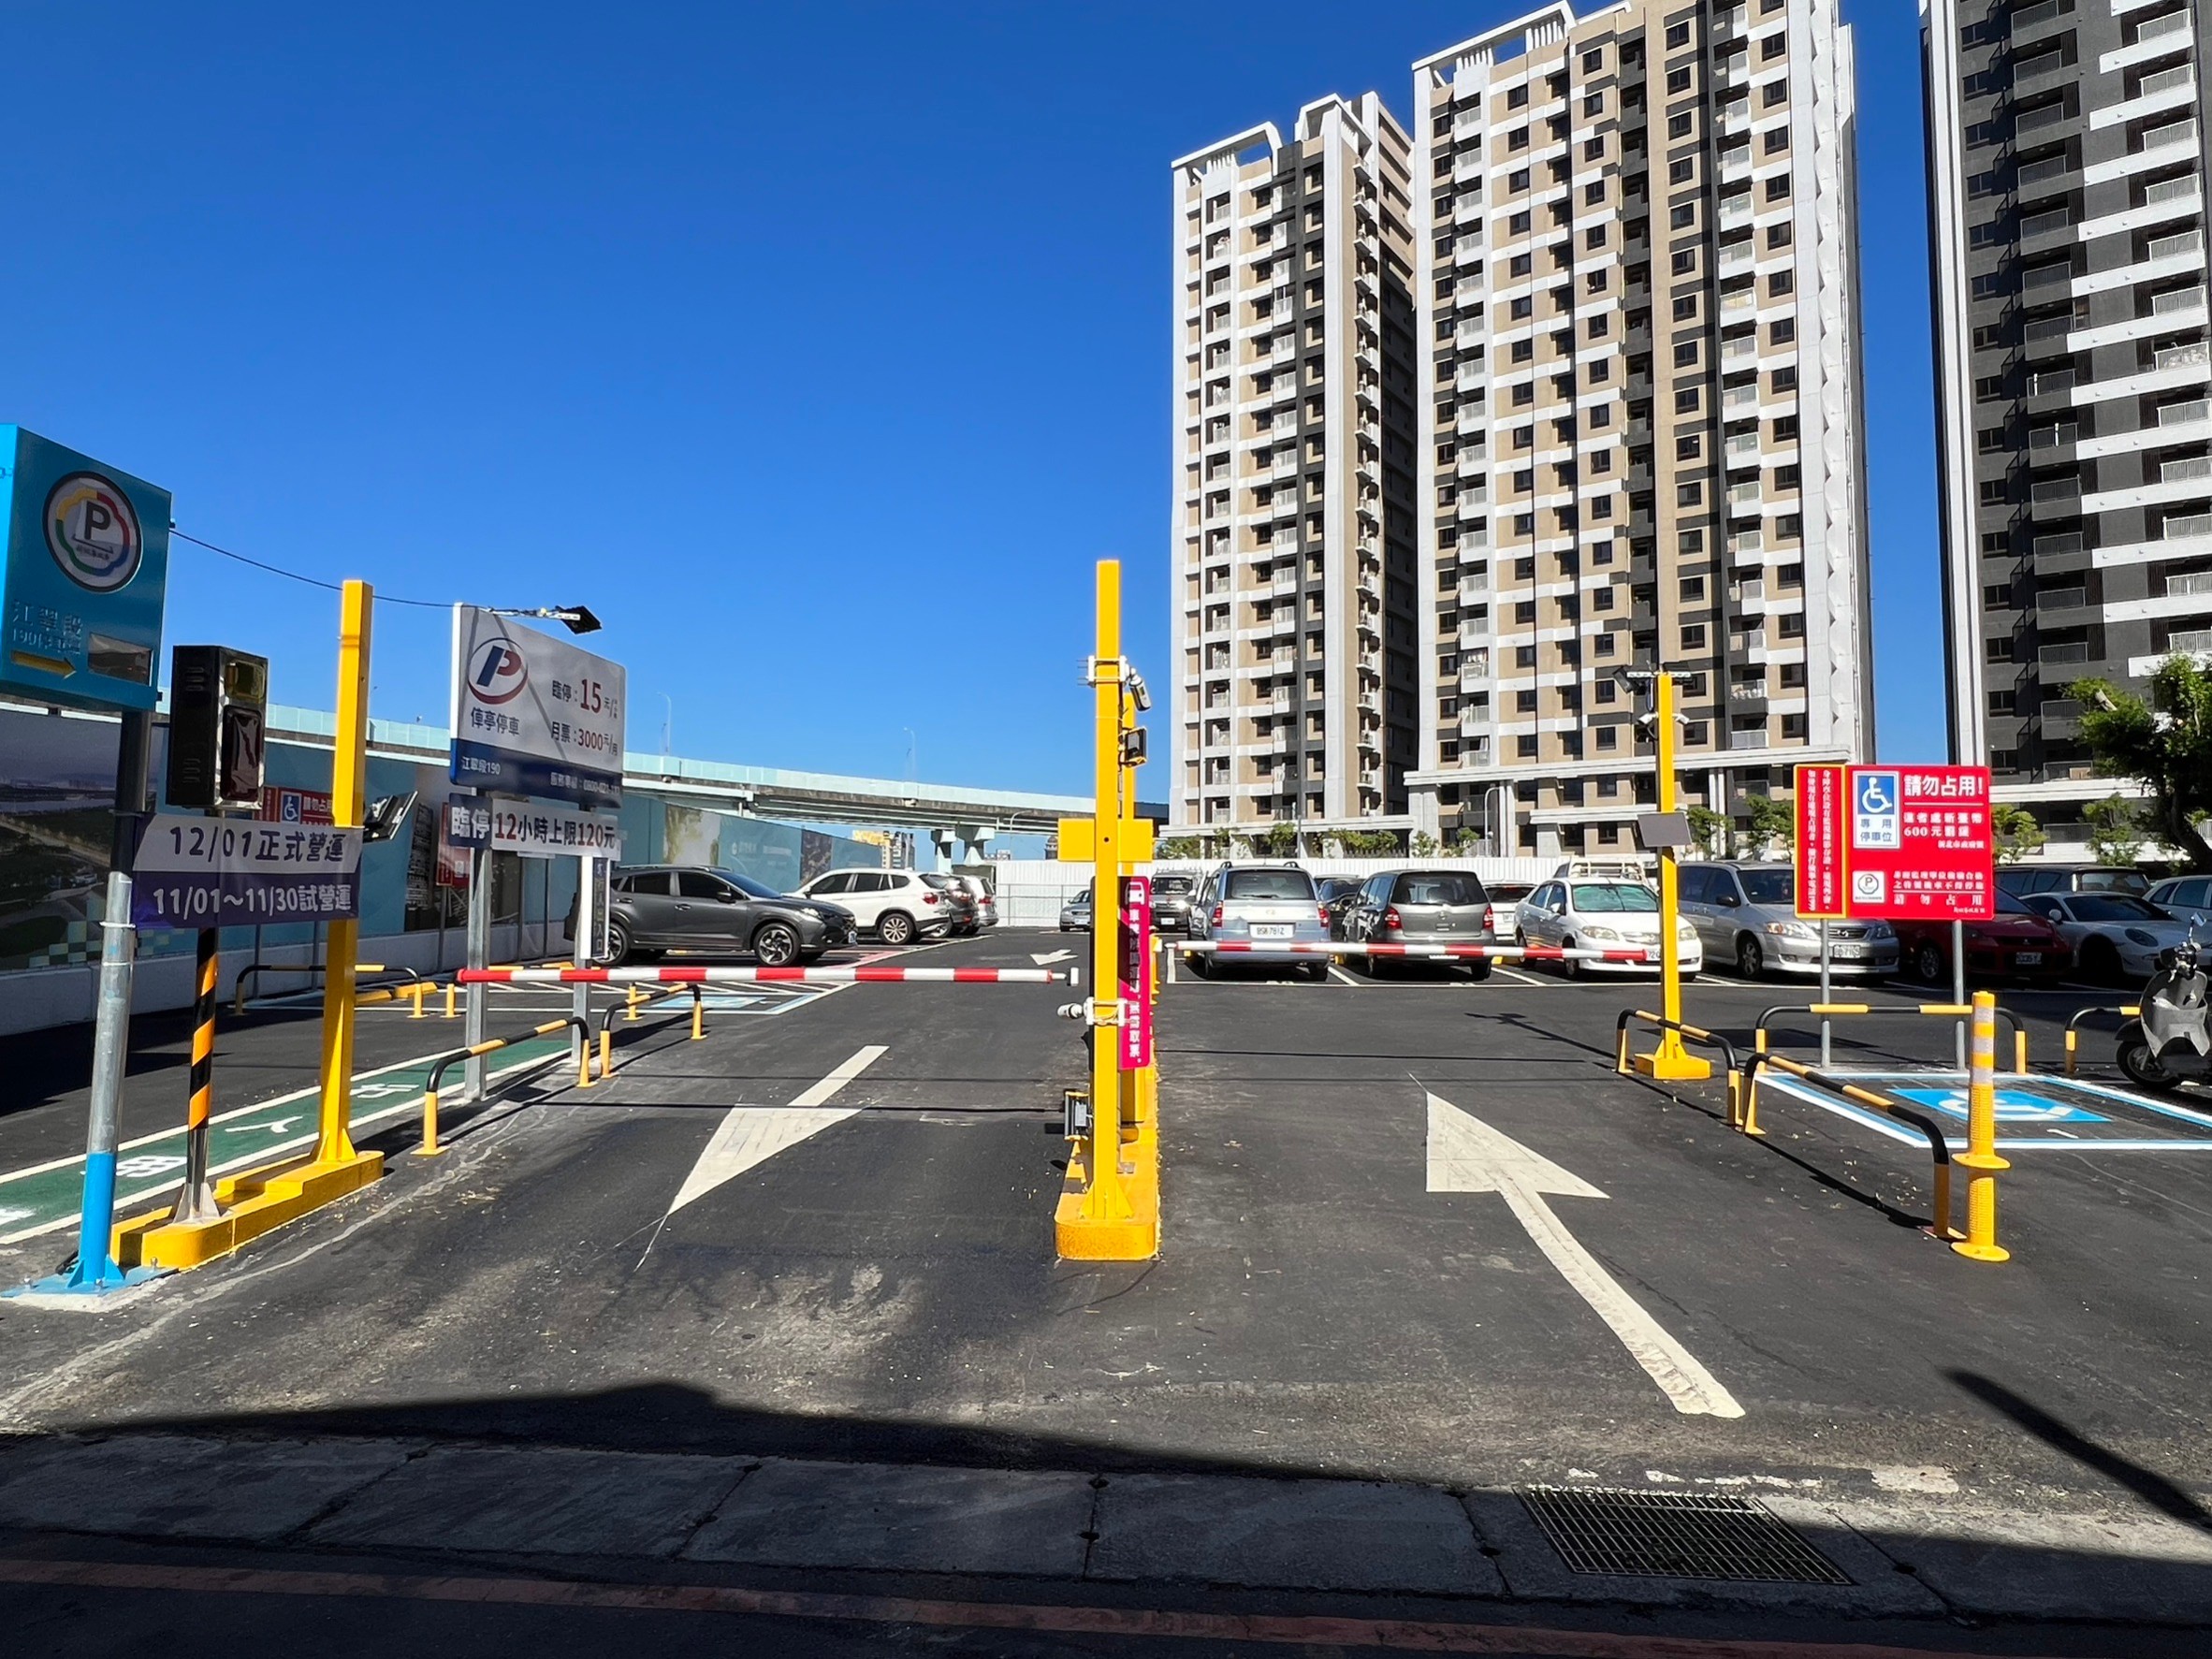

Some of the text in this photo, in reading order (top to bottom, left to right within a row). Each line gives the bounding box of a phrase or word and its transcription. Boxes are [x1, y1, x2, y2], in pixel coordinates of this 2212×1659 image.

[451, 807, 490, 840] 臨停
[494, 811, 617, 850] 12小時上限120元
[1860, 832, 1892, 842] 停車位
[169, 825, 348, 863] 12/01正式營運
